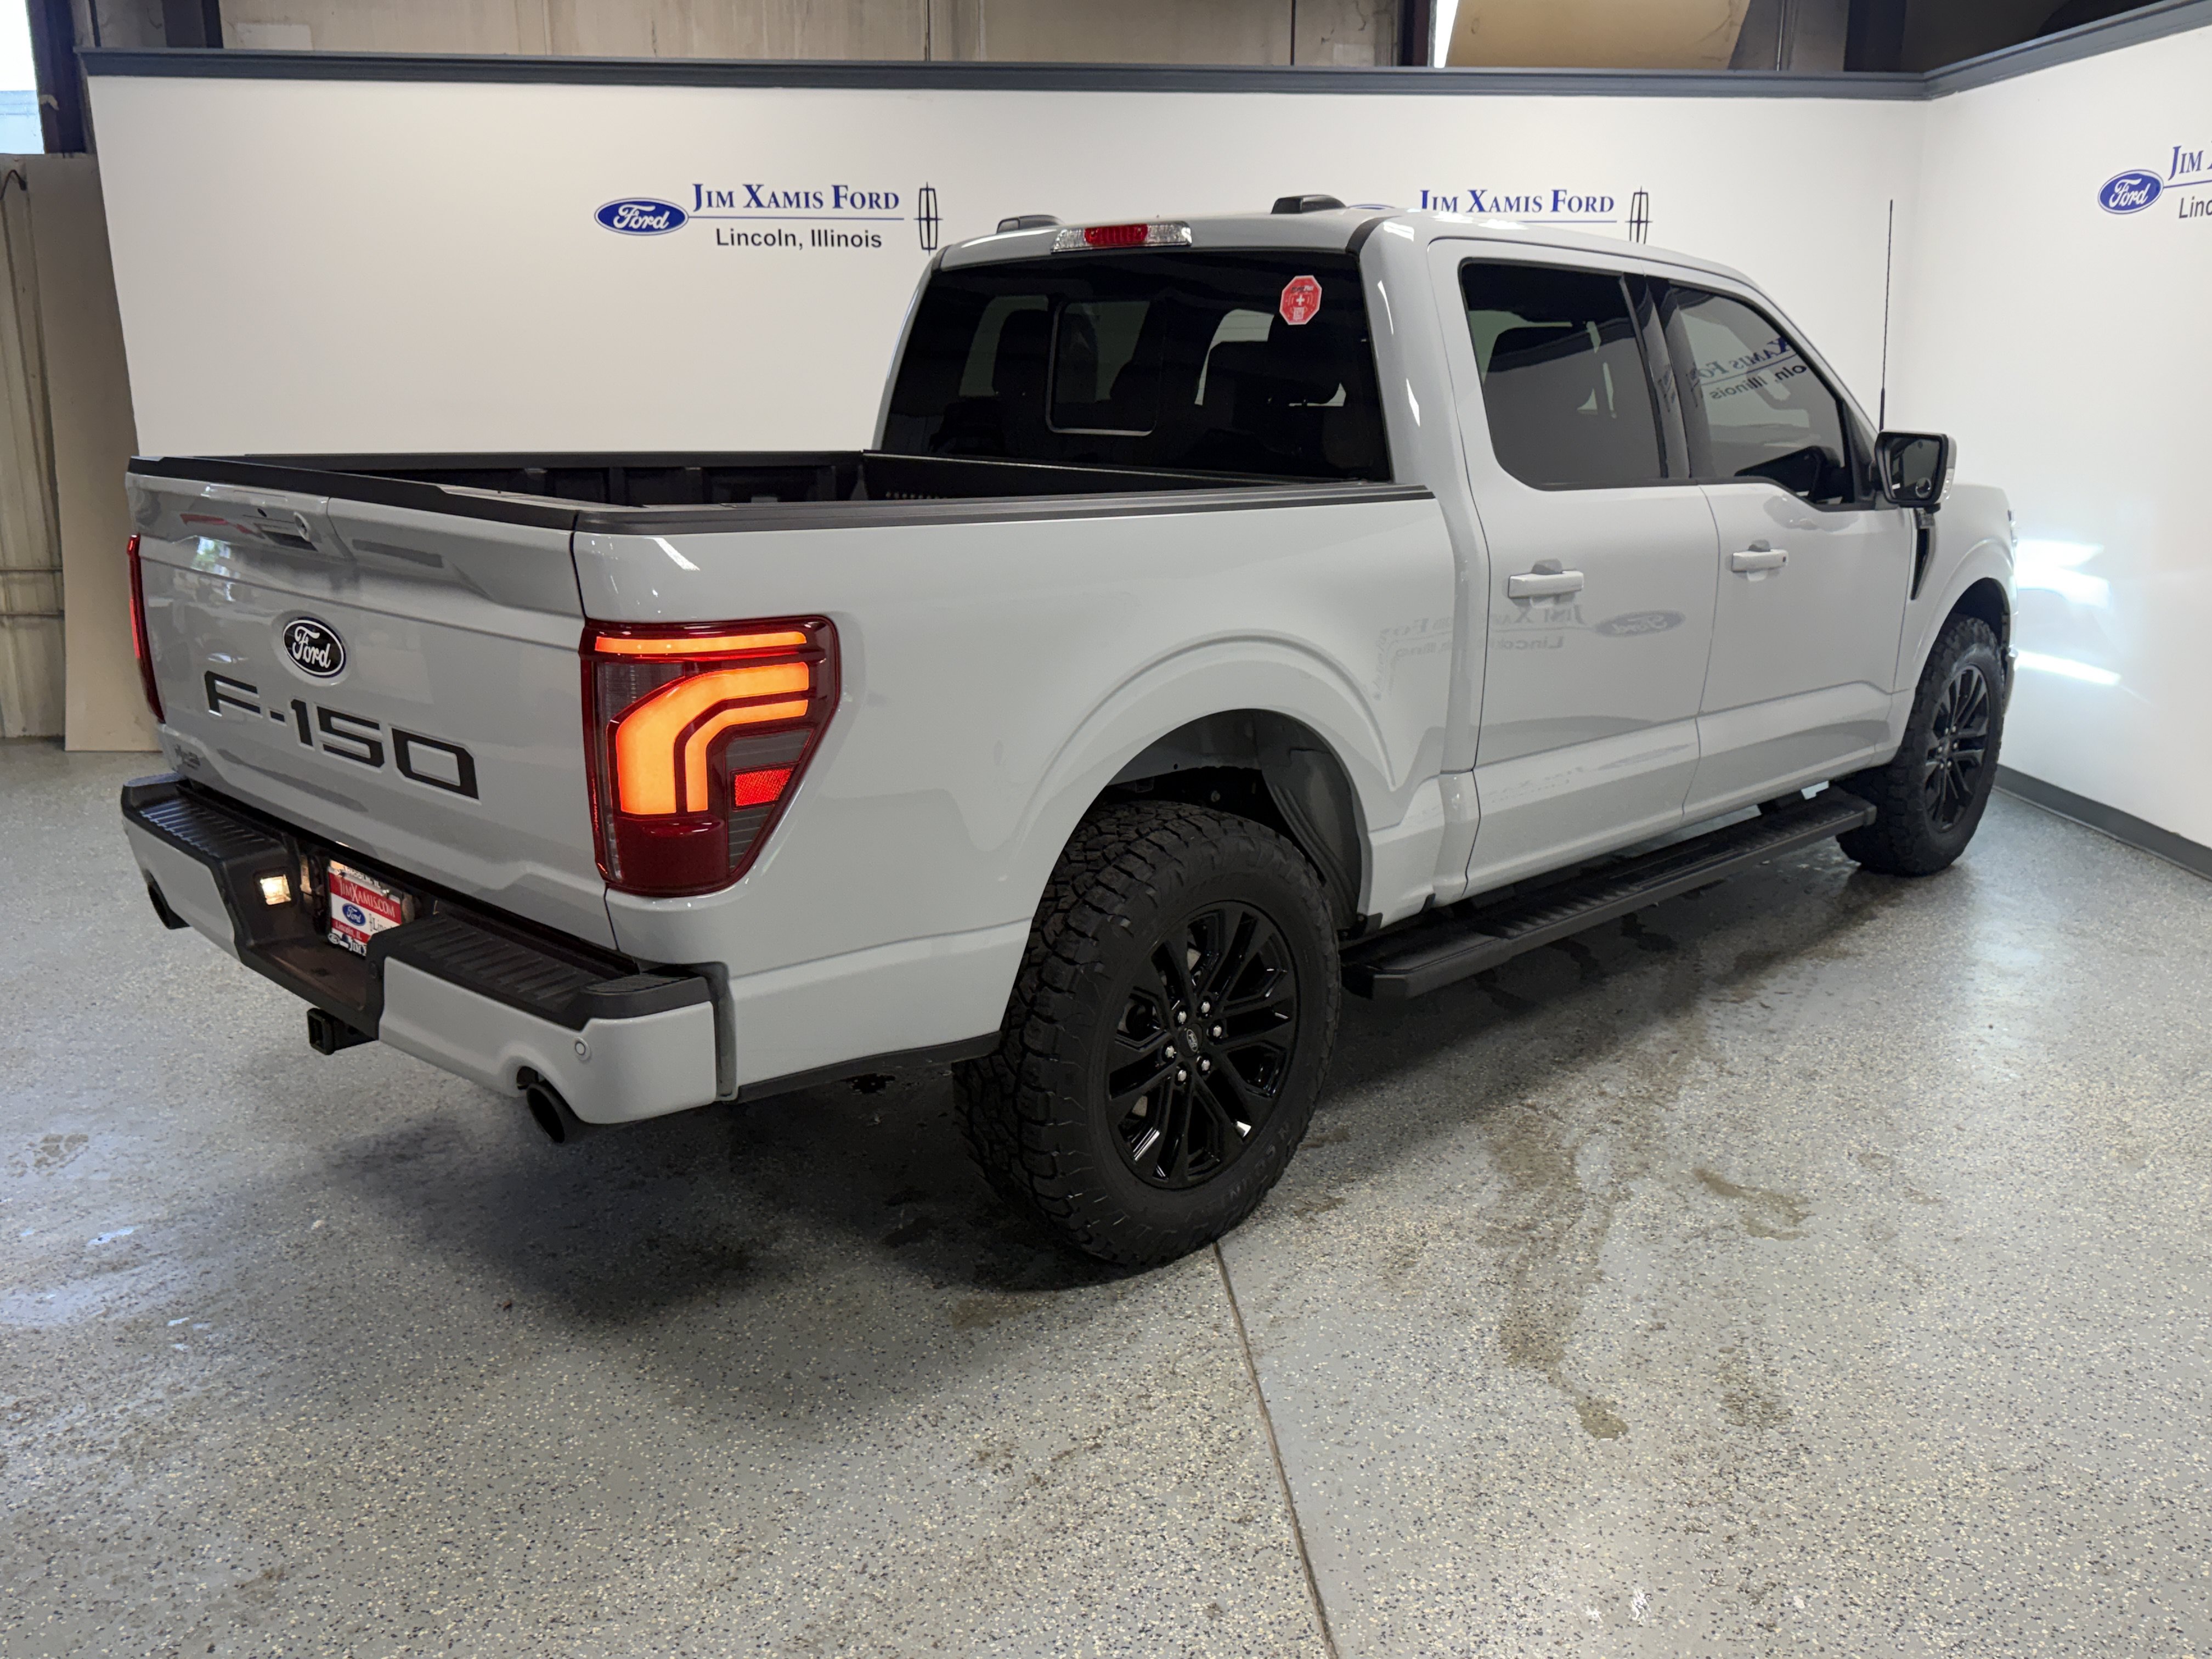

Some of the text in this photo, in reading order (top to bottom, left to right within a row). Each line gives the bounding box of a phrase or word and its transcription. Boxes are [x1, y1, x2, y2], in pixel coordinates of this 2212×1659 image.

[2168, 145, 2204, 181] JIM
[692, 183, 900, 212] JIM XAMIS FORD
[1465, 189, 1543, 213] XAMIS
[1550, 189, 1615, 213] FORD
[2108, 178, 2151, 208] Ford
[612, 203, 670, 230] Ford
[715, 228, 883, 250] Lincoln, Illinois
[292, 625, 331, 669] Ford
[204, 670, 481, 802] F-150
